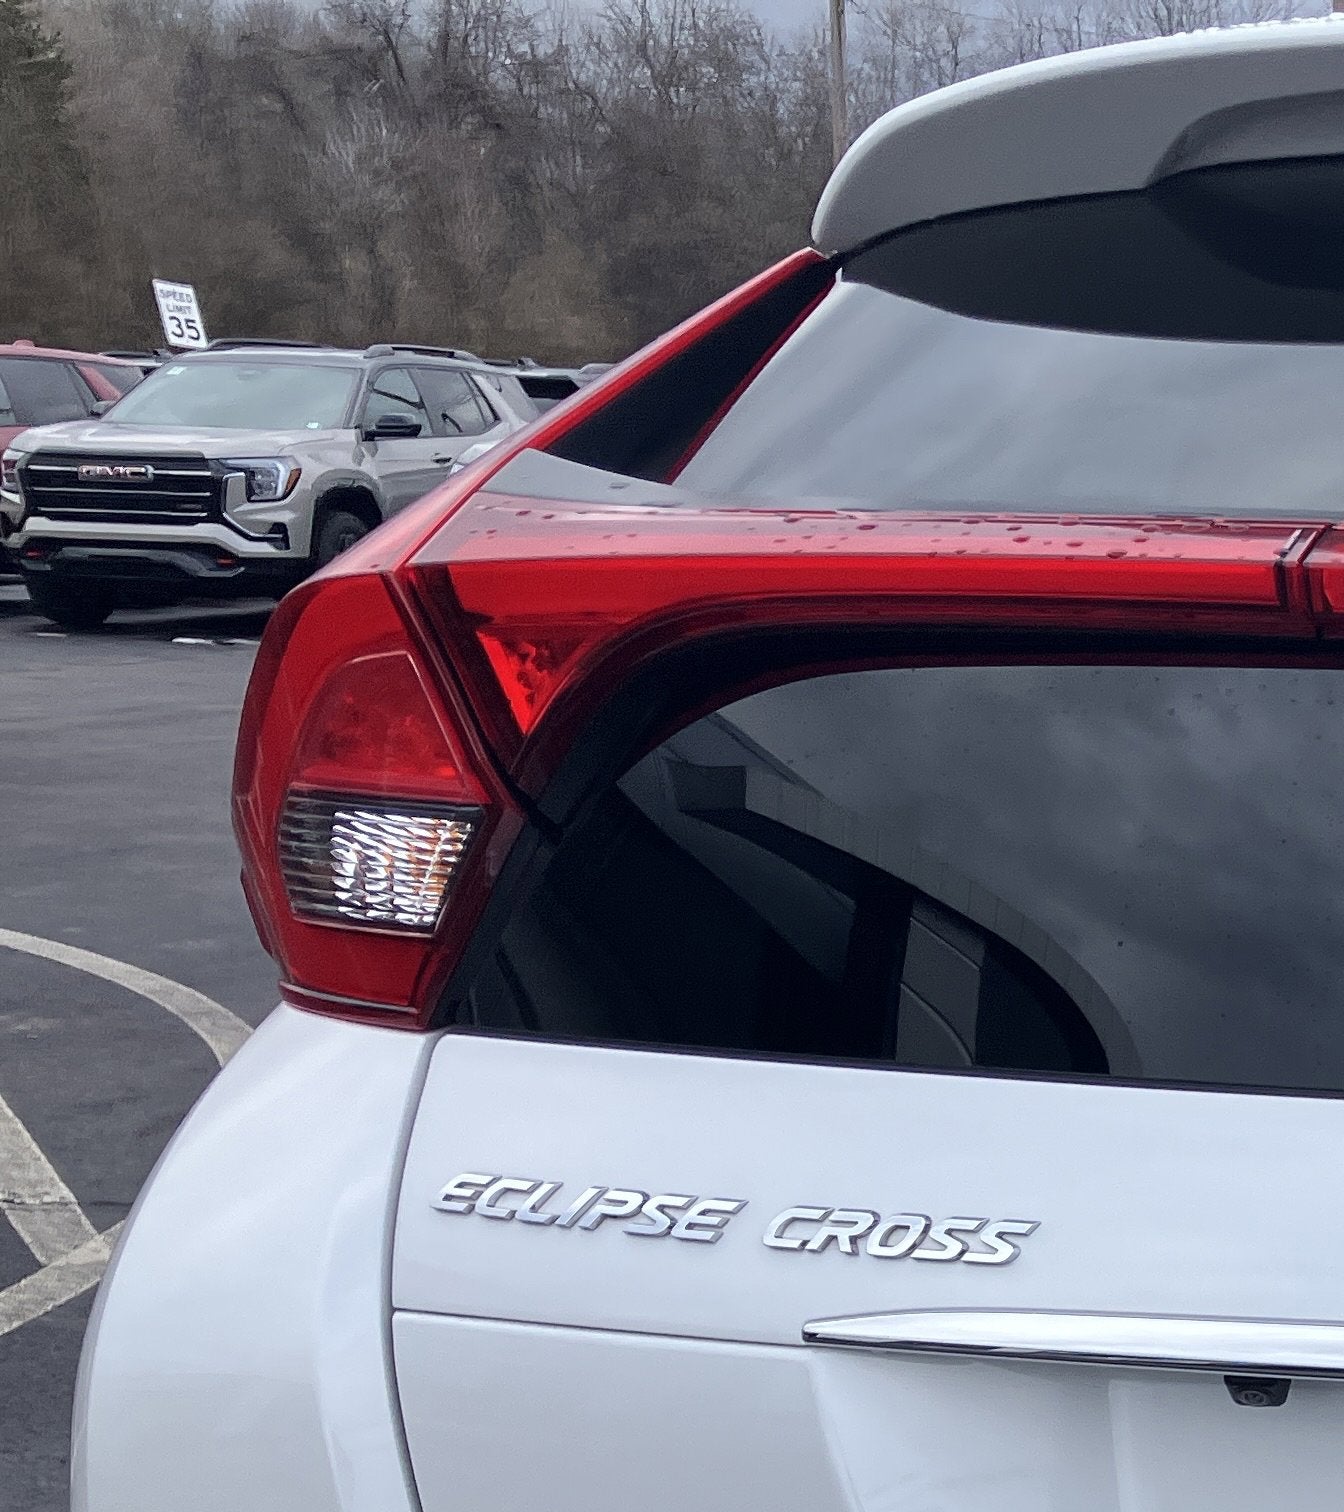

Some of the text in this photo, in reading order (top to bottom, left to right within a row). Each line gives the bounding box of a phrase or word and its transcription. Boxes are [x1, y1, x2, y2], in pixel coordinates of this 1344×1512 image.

[160, 289, 193, 303] SPEED
[166, 303, 192, 315] LIMIT
[169, 316, 200, 341] 35
[79, 465, 154, 482] GMC
[431, 1172, 1042, 1267] ECLIPSE CROSS
